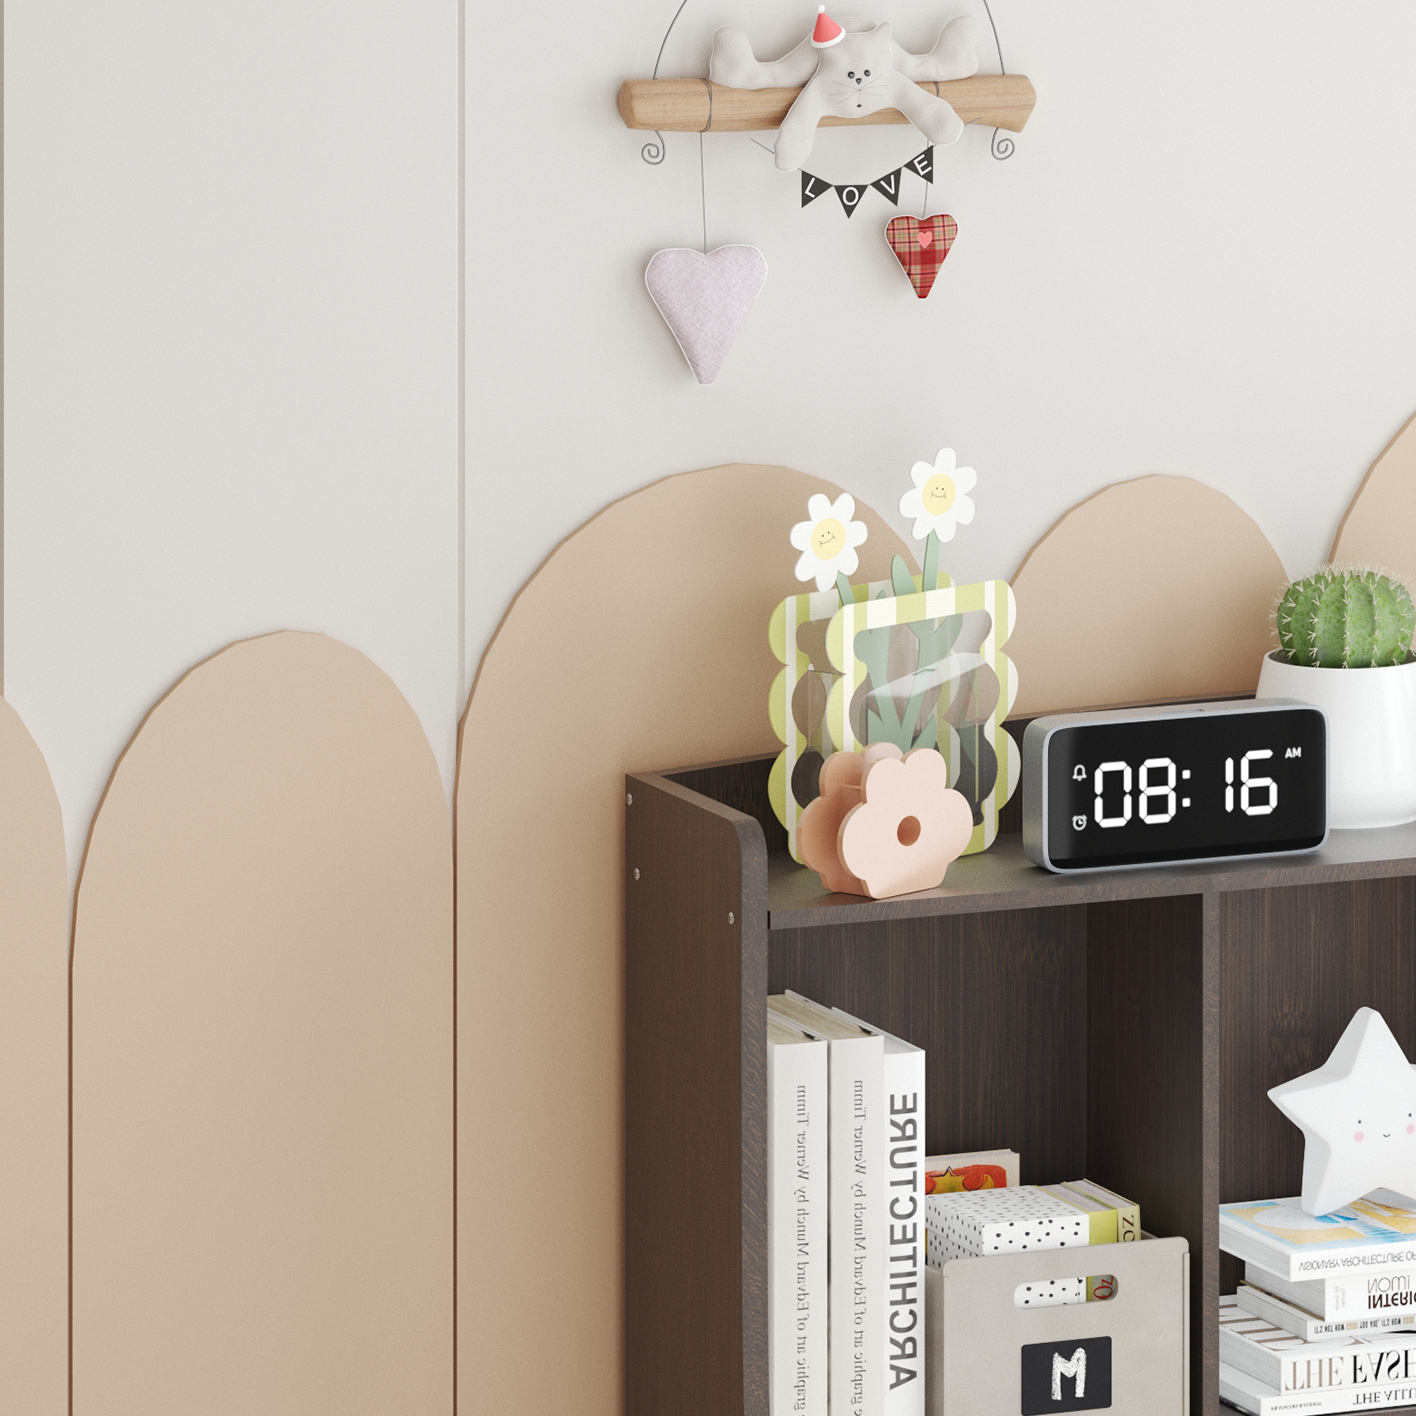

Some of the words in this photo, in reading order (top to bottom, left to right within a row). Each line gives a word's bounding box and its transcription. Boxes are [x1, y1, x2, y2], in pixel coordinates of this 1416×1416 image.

[804, 154, 932, 205] LOVE
[1285, 747, 1302, 759] AM
[1051, 1347, 1087, 1401] M
